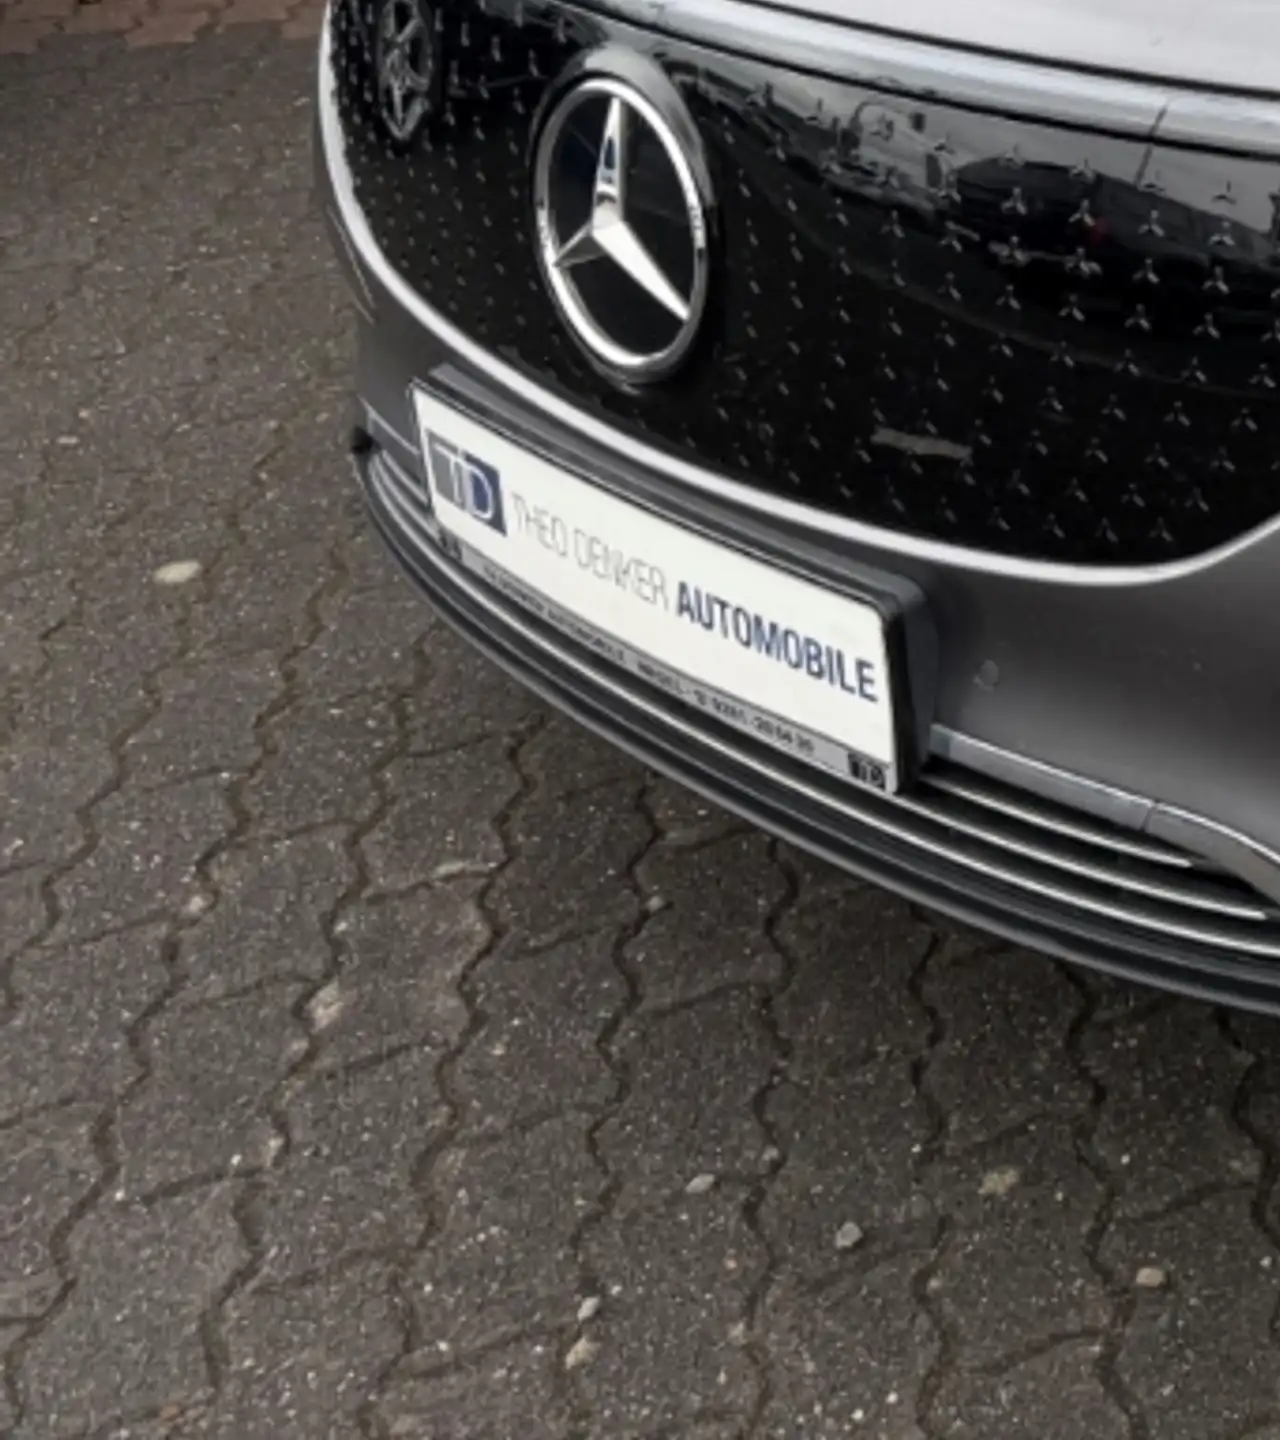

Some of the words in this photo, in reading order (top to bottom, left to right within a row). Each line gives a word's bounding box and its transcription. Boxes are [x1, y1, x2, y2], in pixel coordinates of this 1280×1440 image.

[511, 490, 571, 558] THEO
[573, 525, 671, 613] DENKER
[675, 581, 879, 703] AUTOMOBILE
